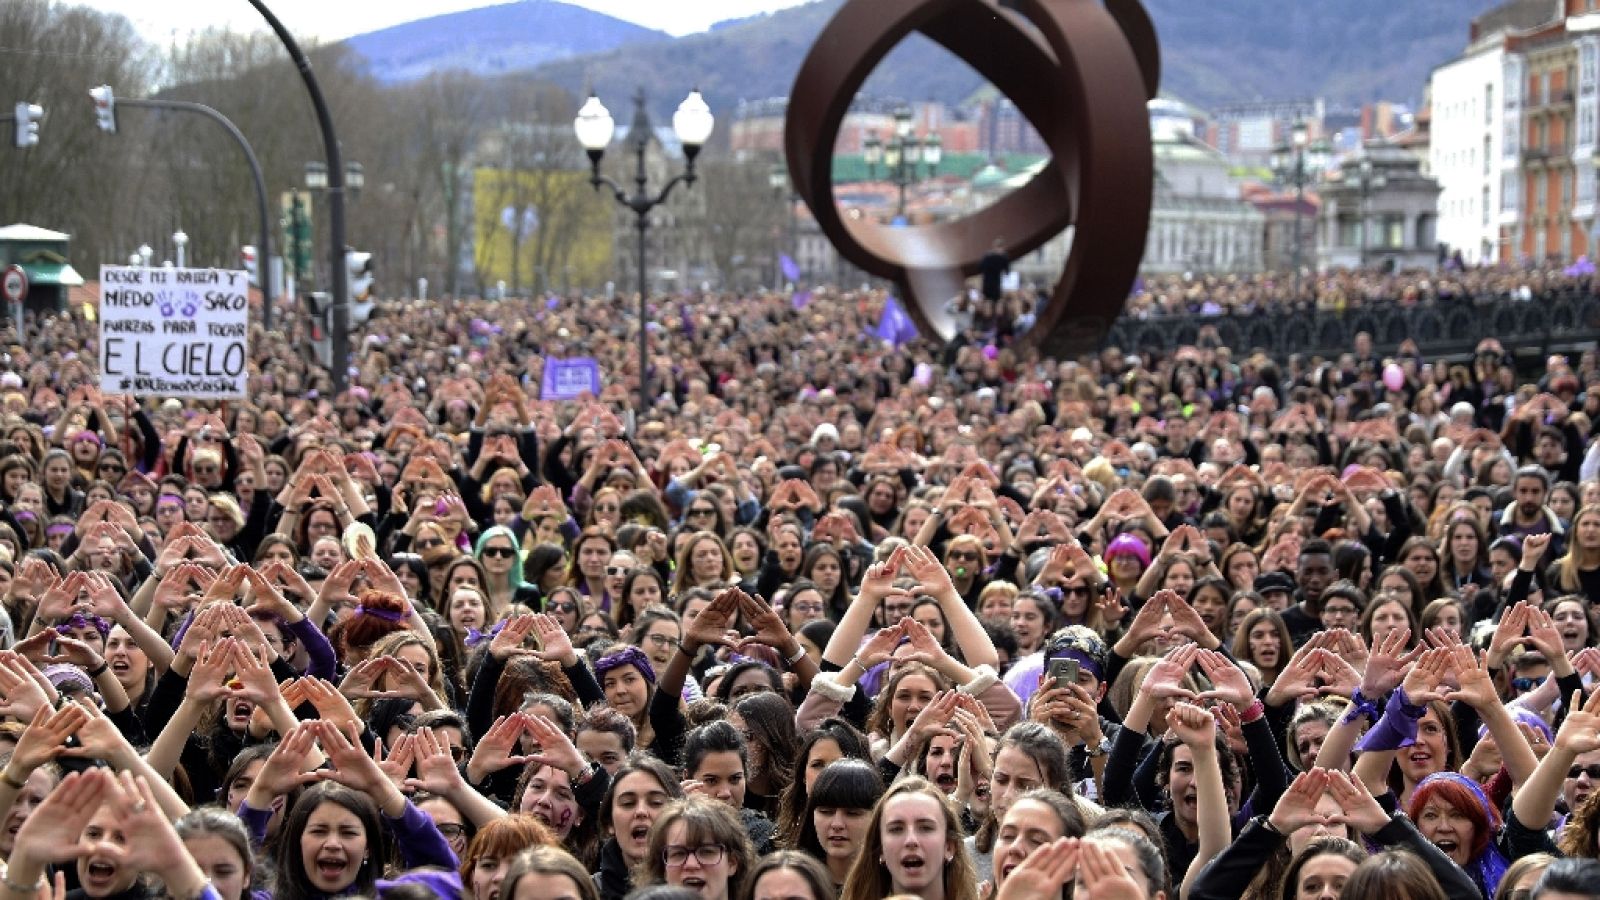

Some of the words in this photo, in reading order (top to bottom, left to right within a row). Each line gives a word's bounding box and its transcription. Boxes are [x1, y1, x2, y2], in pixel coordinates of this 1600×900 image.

[105, 272, 142, 284] DESDE
[150, 272, 167, 284] MI
[176, 272, 219, 284] RABIA
[227, 273, 239, 286] Y
[105, 287, 154, 307] MIEDO
[204, 291, 246, 311] SACO
[104, 320, 155, 333] FUERZAS
[163, 320, 196, 334] PARA
[208, 322, 245, 337] TOCAR
[163, 342, 245, 377] CIELO
